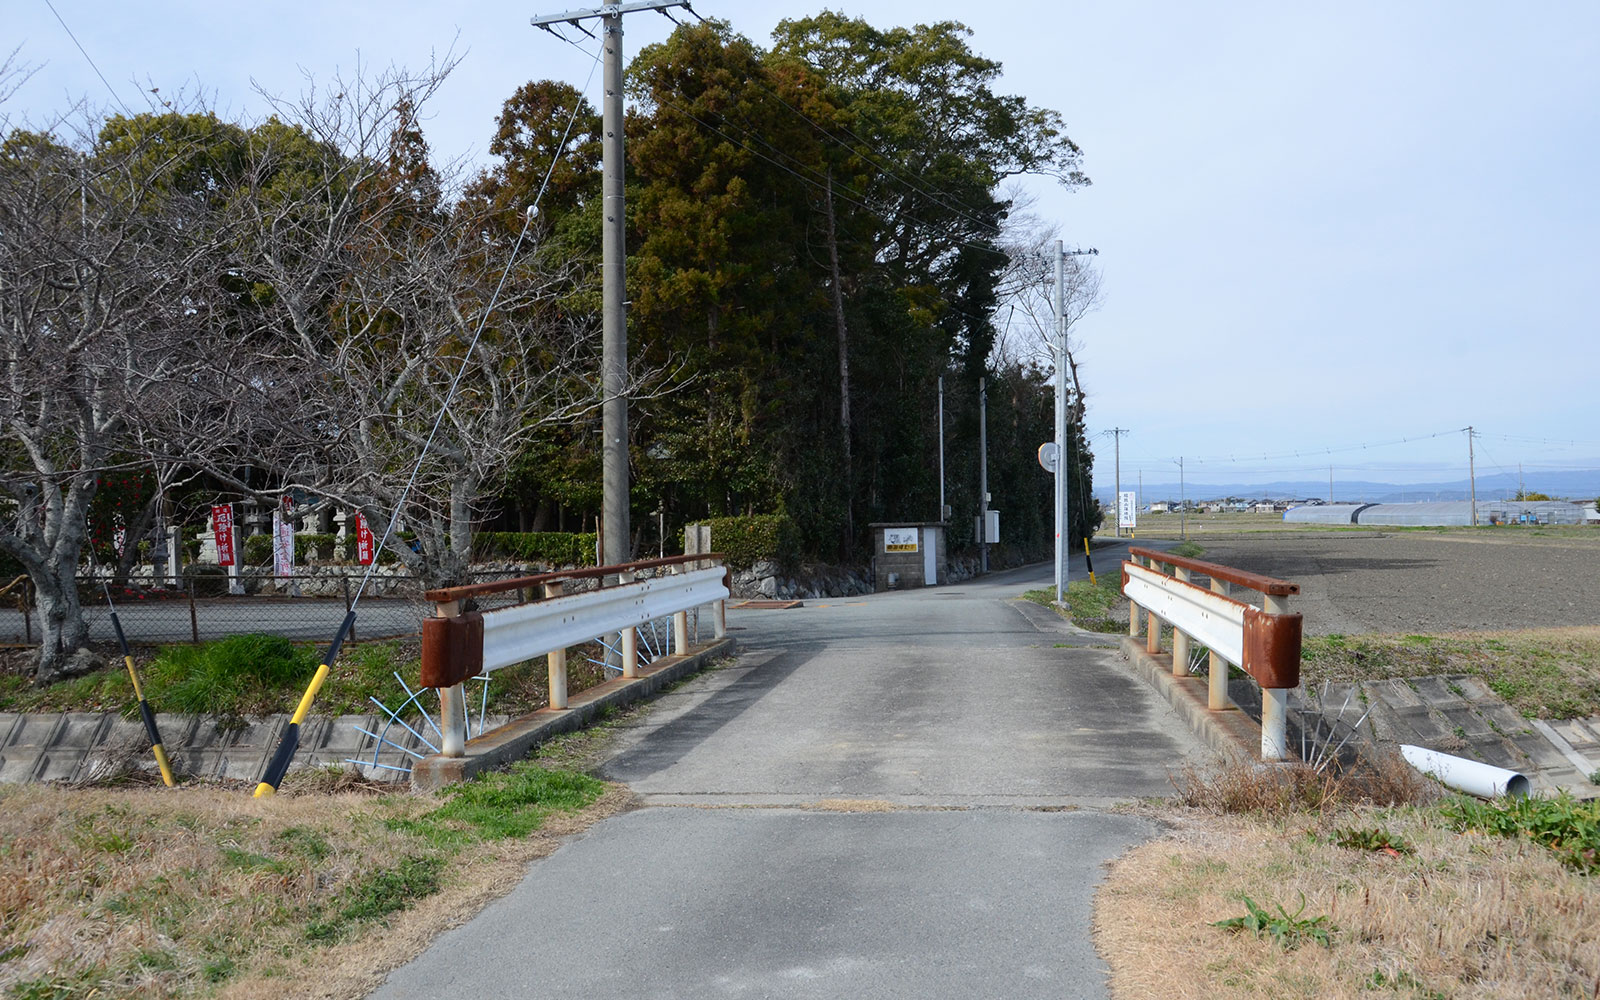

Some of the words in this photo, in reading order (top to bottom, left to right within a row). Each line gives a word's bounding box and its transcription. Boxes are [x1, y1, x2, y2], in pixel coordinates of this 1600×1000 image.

[279, 522, 291, 579] 通安全祈願
